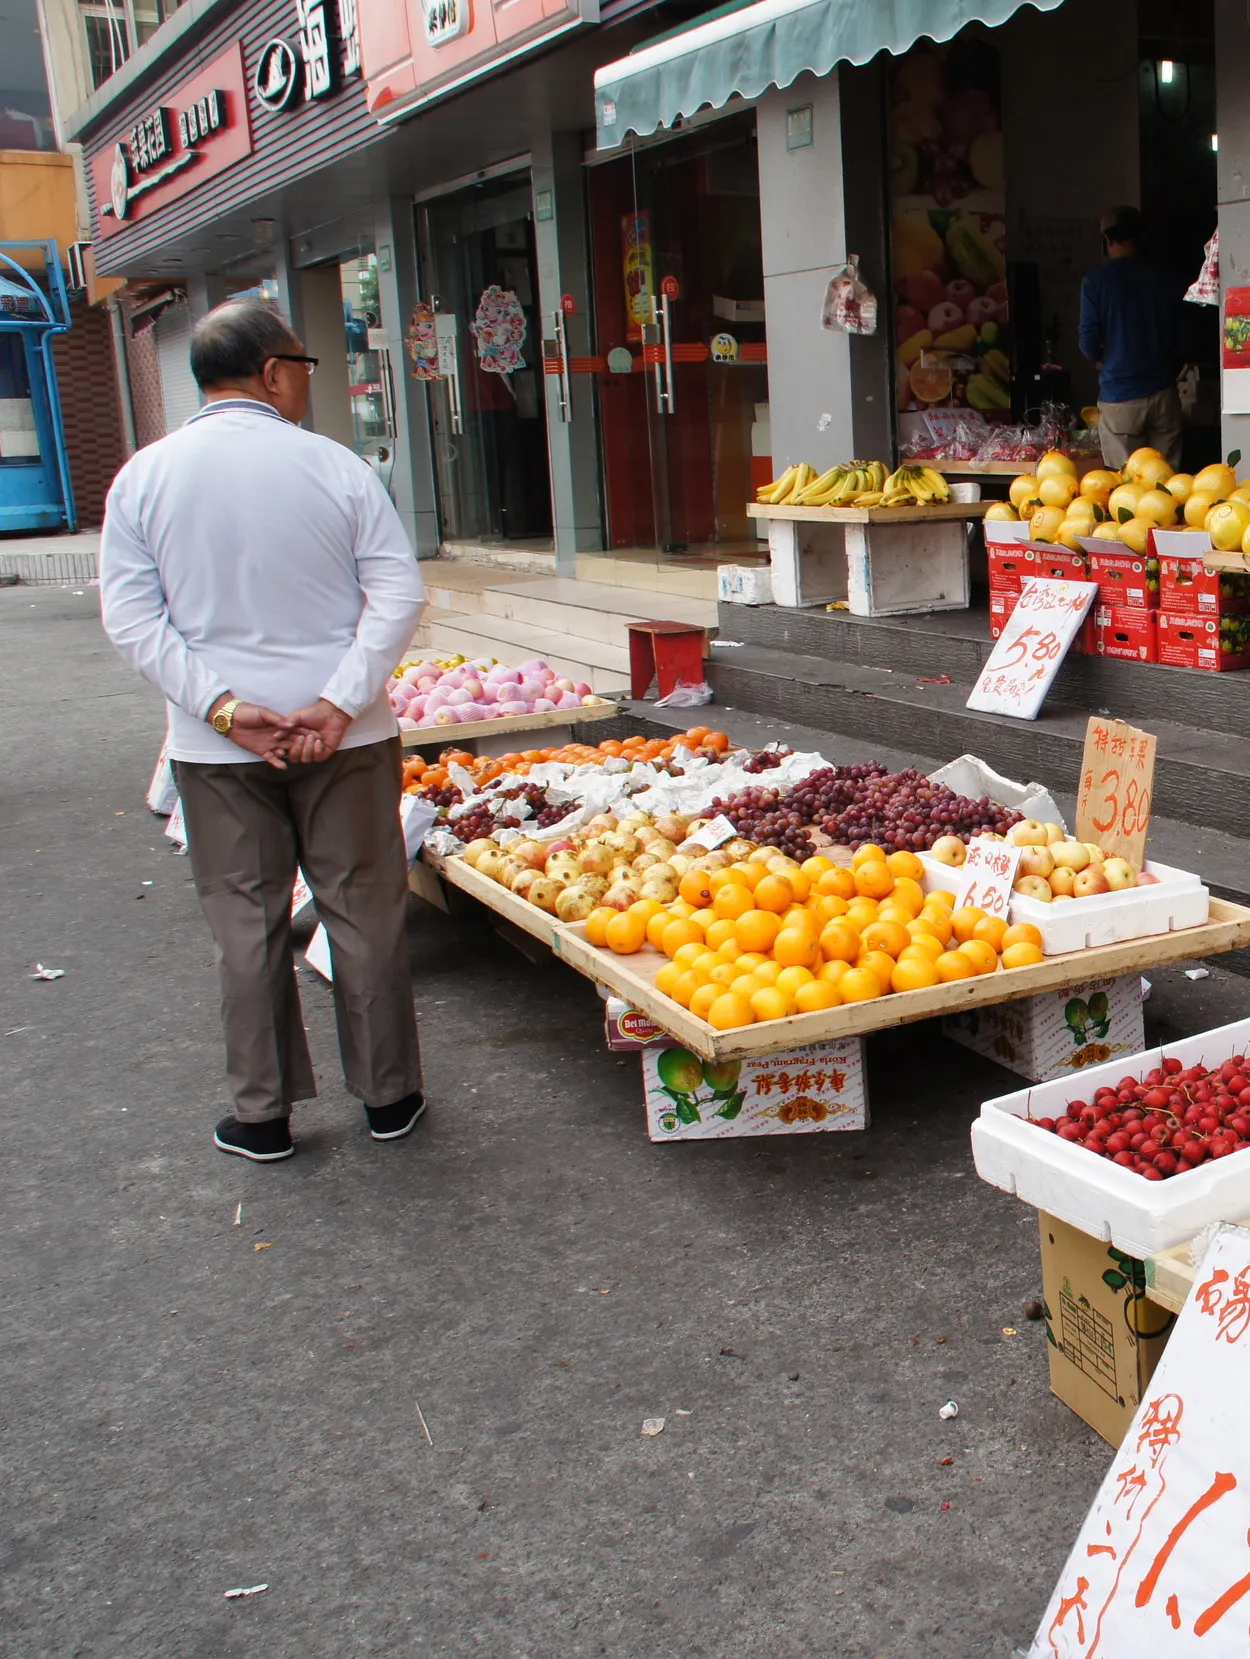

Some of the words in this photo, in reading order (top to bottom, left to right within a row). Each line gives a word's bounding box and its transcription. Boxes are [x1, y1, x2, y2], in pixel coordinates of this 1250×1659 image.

[1092, 769, 1150, 837] 3.80
[746, 1060, 769, 1069] Pear
[770, 1057, 816, 1067] Fragrant
[819, 1056, 847, 1066] Korla
